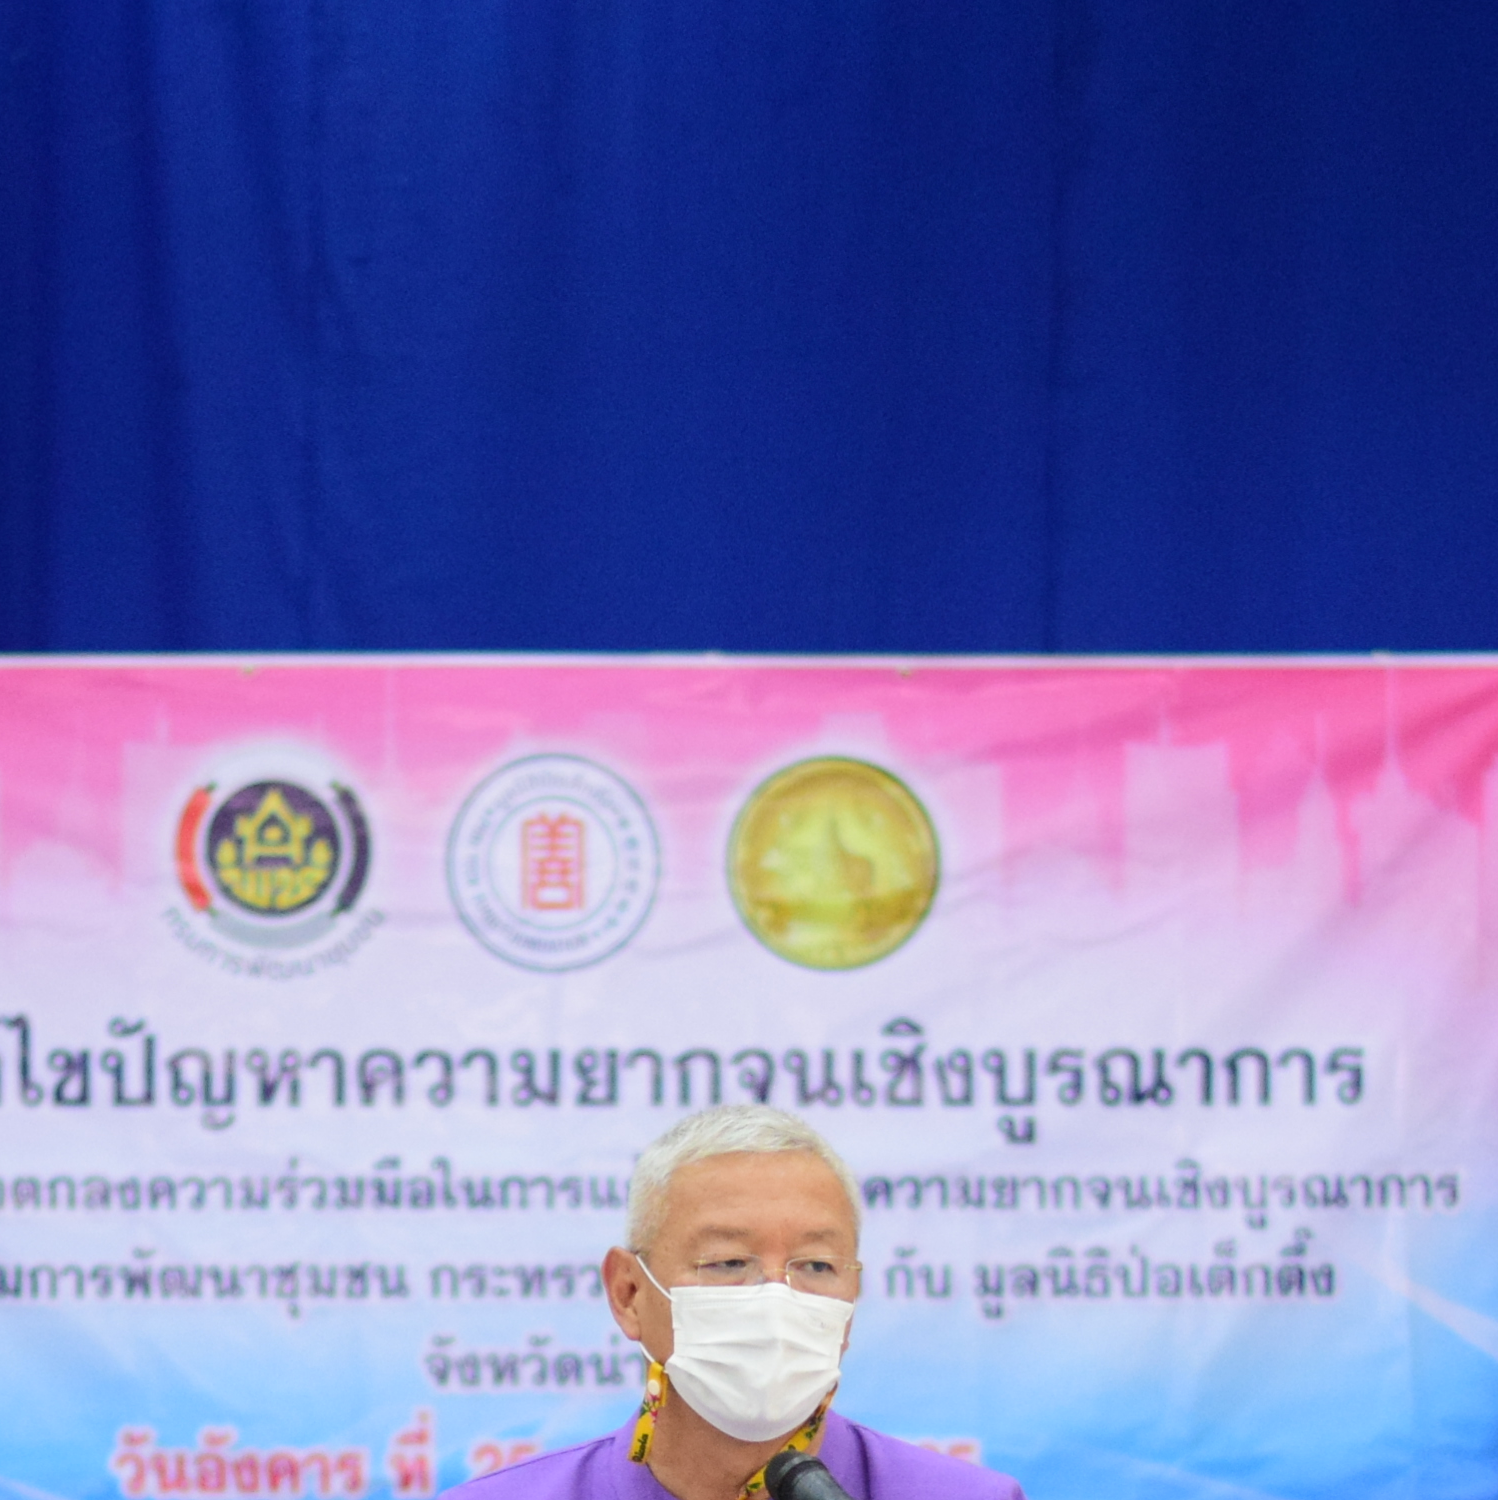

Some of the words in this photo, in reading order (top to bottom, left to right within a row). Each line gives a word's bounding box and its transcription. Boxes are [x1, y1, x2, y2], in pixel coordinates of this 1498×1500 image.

[885, 1246, 952, 1298] กับ
[113, 1432, 364, 1493] วันอังคาร
[390, 1411, 431, 1493] ที่
